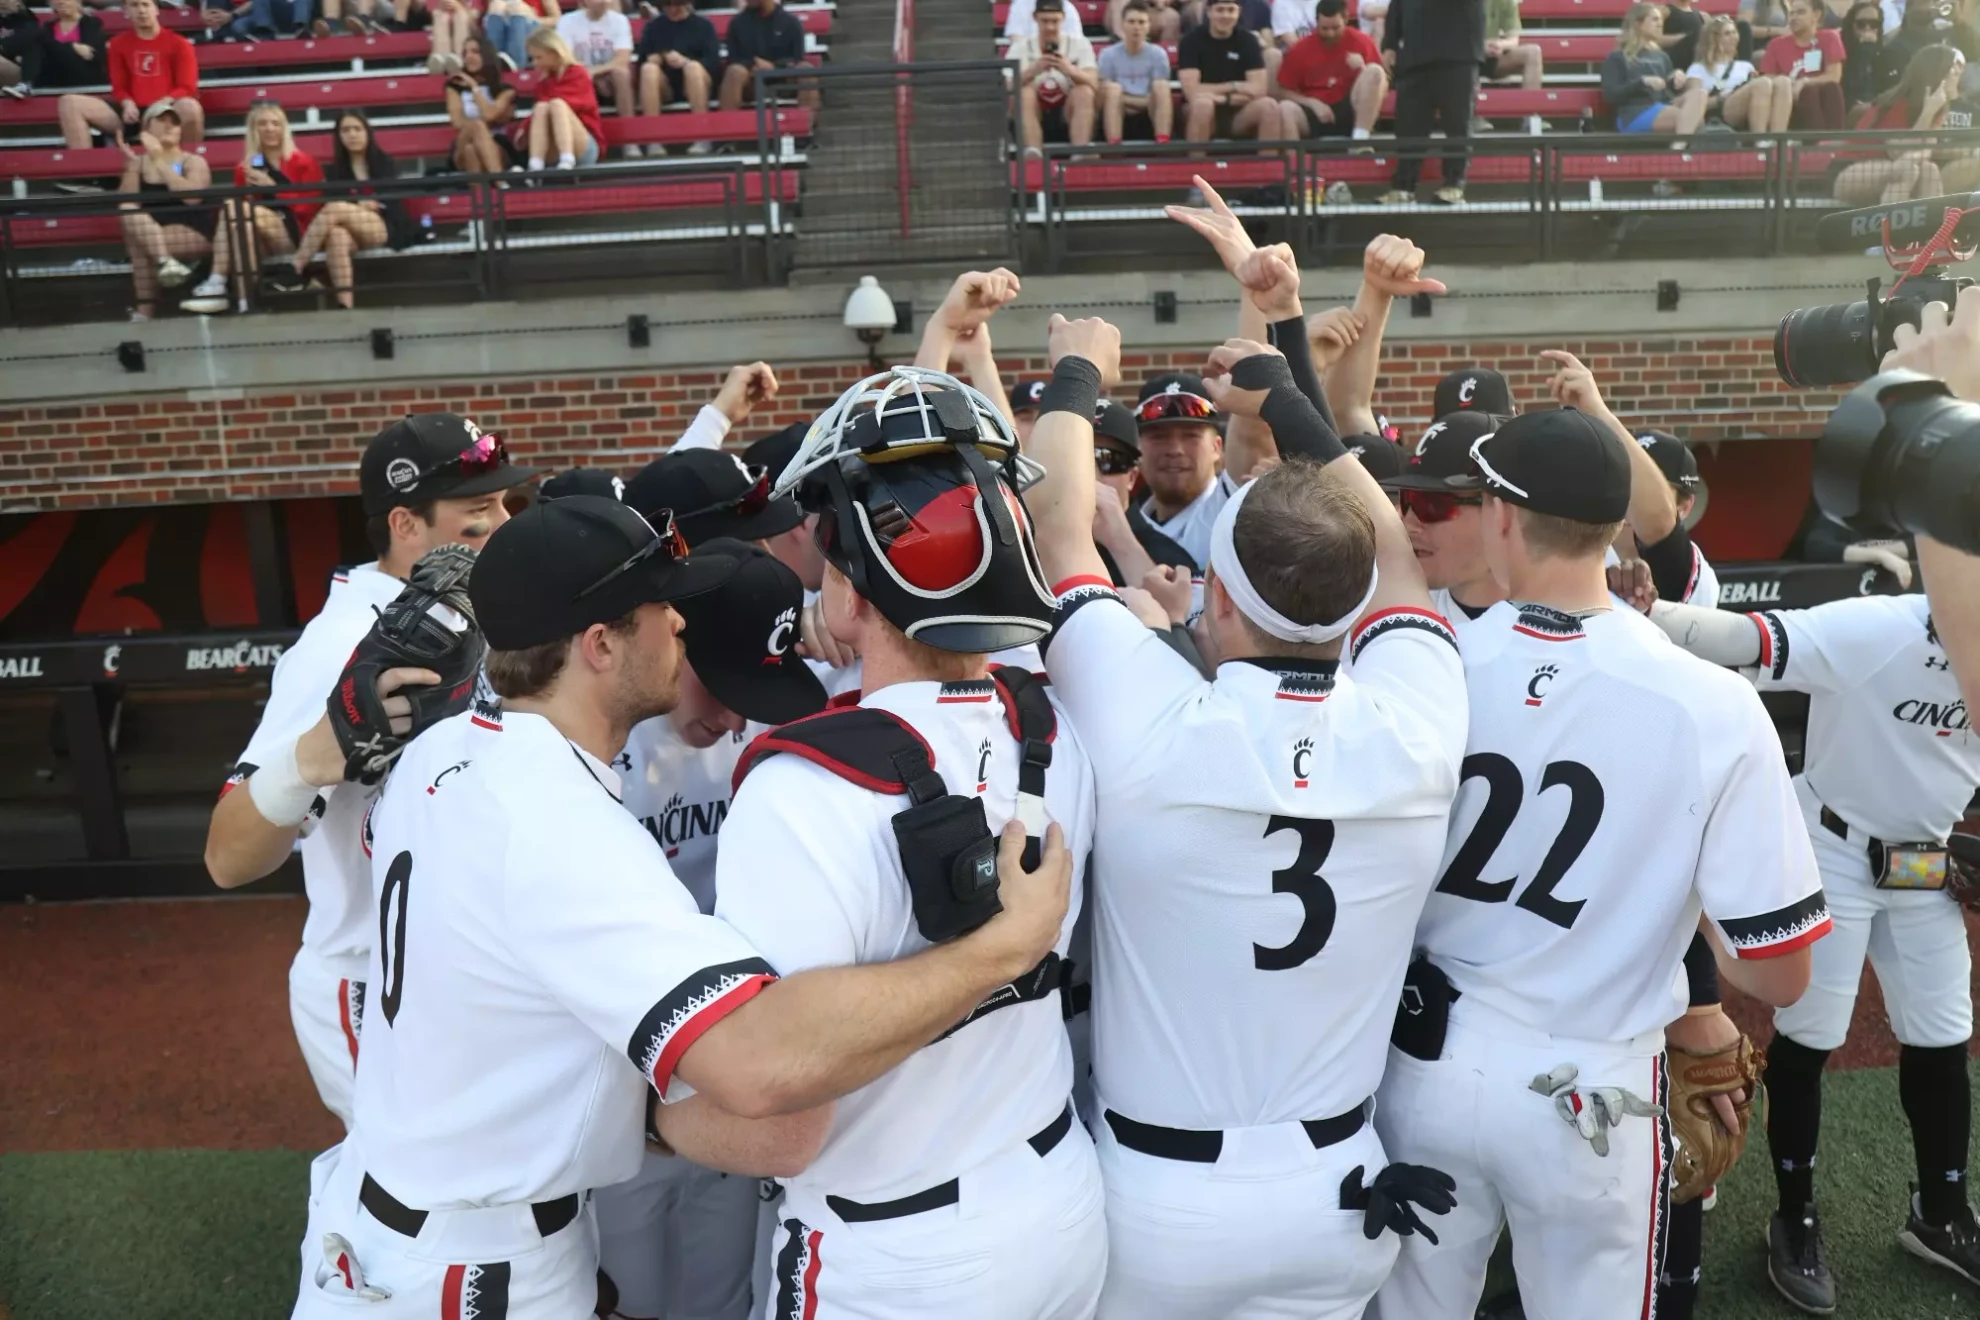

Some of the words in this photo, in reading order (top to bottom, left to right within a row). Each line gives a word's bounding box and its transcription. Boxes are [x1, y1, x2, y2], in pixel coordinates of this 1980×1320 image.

[1719, 582, 1781, 603] EBALL
[186, 640, 283, 670] BEARCATS
[1893, 697, 1971, 730] CINCI
[1435, 752, 1605, 930] 22
[380, 850, 413, 1030] 0
[1253, 814, 1337, 971] 3
